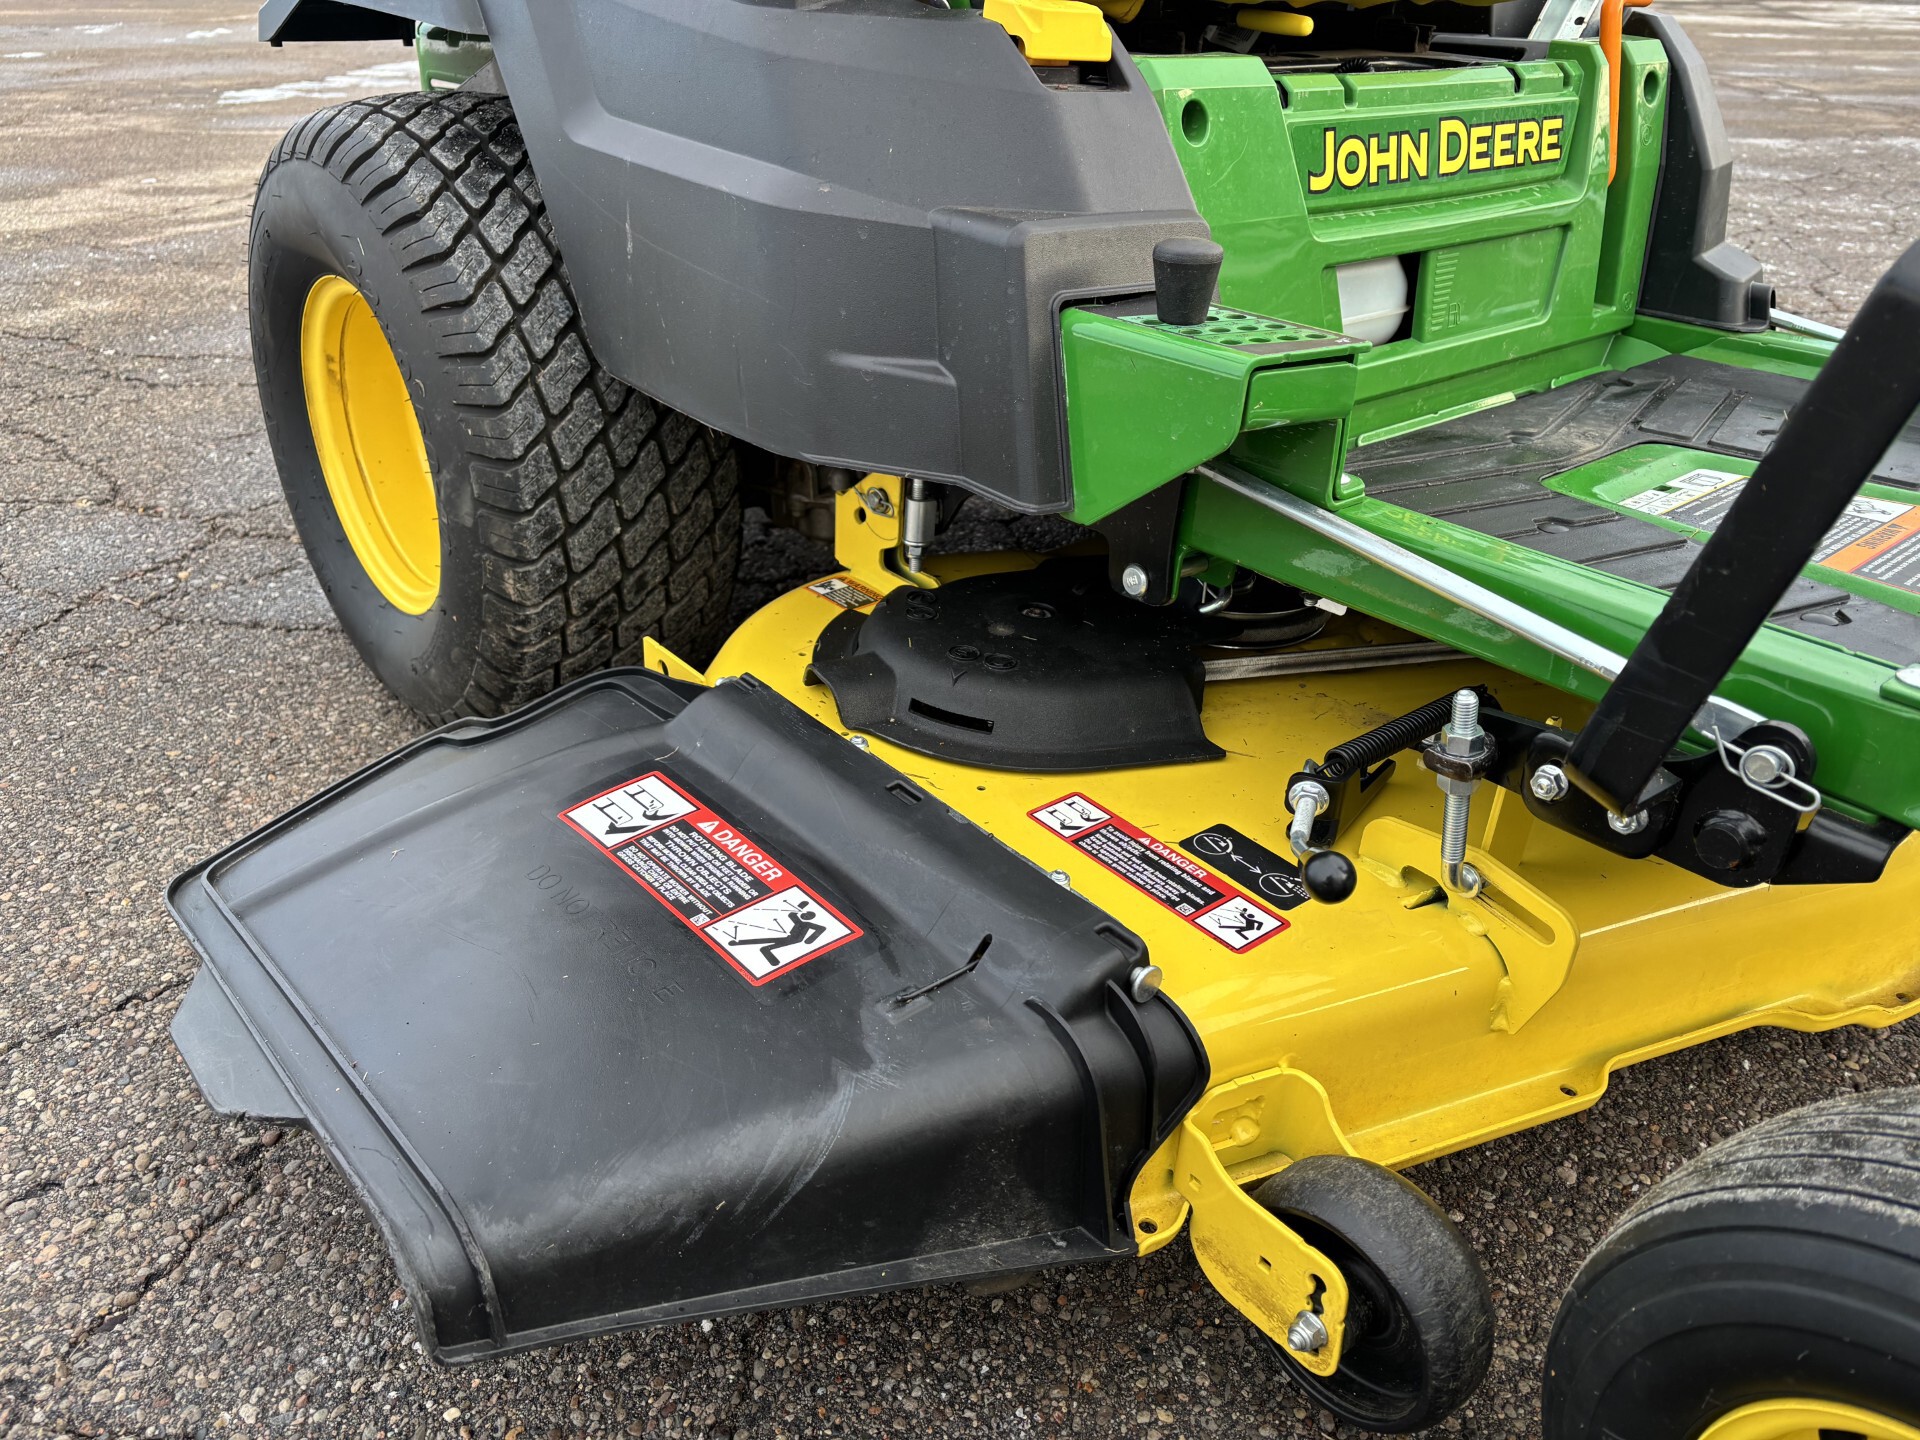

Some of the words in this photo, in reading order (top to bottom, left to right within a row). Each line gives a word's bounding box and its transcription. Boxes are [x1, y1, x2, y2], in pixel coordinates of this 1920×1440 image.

[1308, 127, 1430, 194] JOHN
[1438, 115, 1565, 177] DEERE
[688, 831, 728, 861] ROTATING
[724, 860, 754, 882] BLADE
[711, 828, 785, 881] DANGER
[1097, 828, 1121, 842] thrown
[1111, 830, 1131, 841] avoid
[1126, 839, 1147, 852] injury
[1142, 850, 1161, 860] from
[1156, 858, 1183, 875] rotating
[1179, 873, 1204, 888] blades
[1199, 885, 1216, 895] and
[1149, 842, 1208, 878] DANGER
[524, 864, 563, 890] DO
[616, 850, 635, 865] GRASS
[630, 863, 655, 882] CATCHER
[656, 885, 676, 900] PLACE
[621, 847, 650, 870] DISCHARGE
[646, 868, 665, 883] CHUTE
[661, 881, 673, 889] OR
[669, 888, 690, 904] ENTIRE
[627, 845, 639, 853] DO
[635, 851, 649, 861] NOT
[645, 859, 671, 880] OPERATE
[667, 878, 690, 895] MOWER
[685, 894, 713, 915] WITHOUT
[638, 838, 654, 849] THAT
[649, 847, 663, 857] MAY
[665, 860, 689, 878] THROWN
[691, 882, 712, 897] BLADE
[645, 835, 666, 850] BEFORE
[678, 862, 697, 876] CLEAR
[692, 874, 709, 886] AREA
[710, 889, 735, 908] OBJECTS
[661, 828, 676, 838] INTO
[672, 836, 693, 852] MOWER
[689, 850, 707, 863] WHEN
[702, 861, 725, 877] ENGINE
[725, 880, 752, 900] RUNNING
[663, 839, 698, 866] THROWN
[694, 865, 733, 894] OBJECTS
[675, 831, 689, 840] NOT
[684, 838, 698, 847] PUT
[694, 846, 715, 860] HANDS
[710, 858, 722, 866] OR
[717, 865, 734, 876] FEET
[729, 874, 751, 890] UNDER
[746, 888, 759, 897] OR
